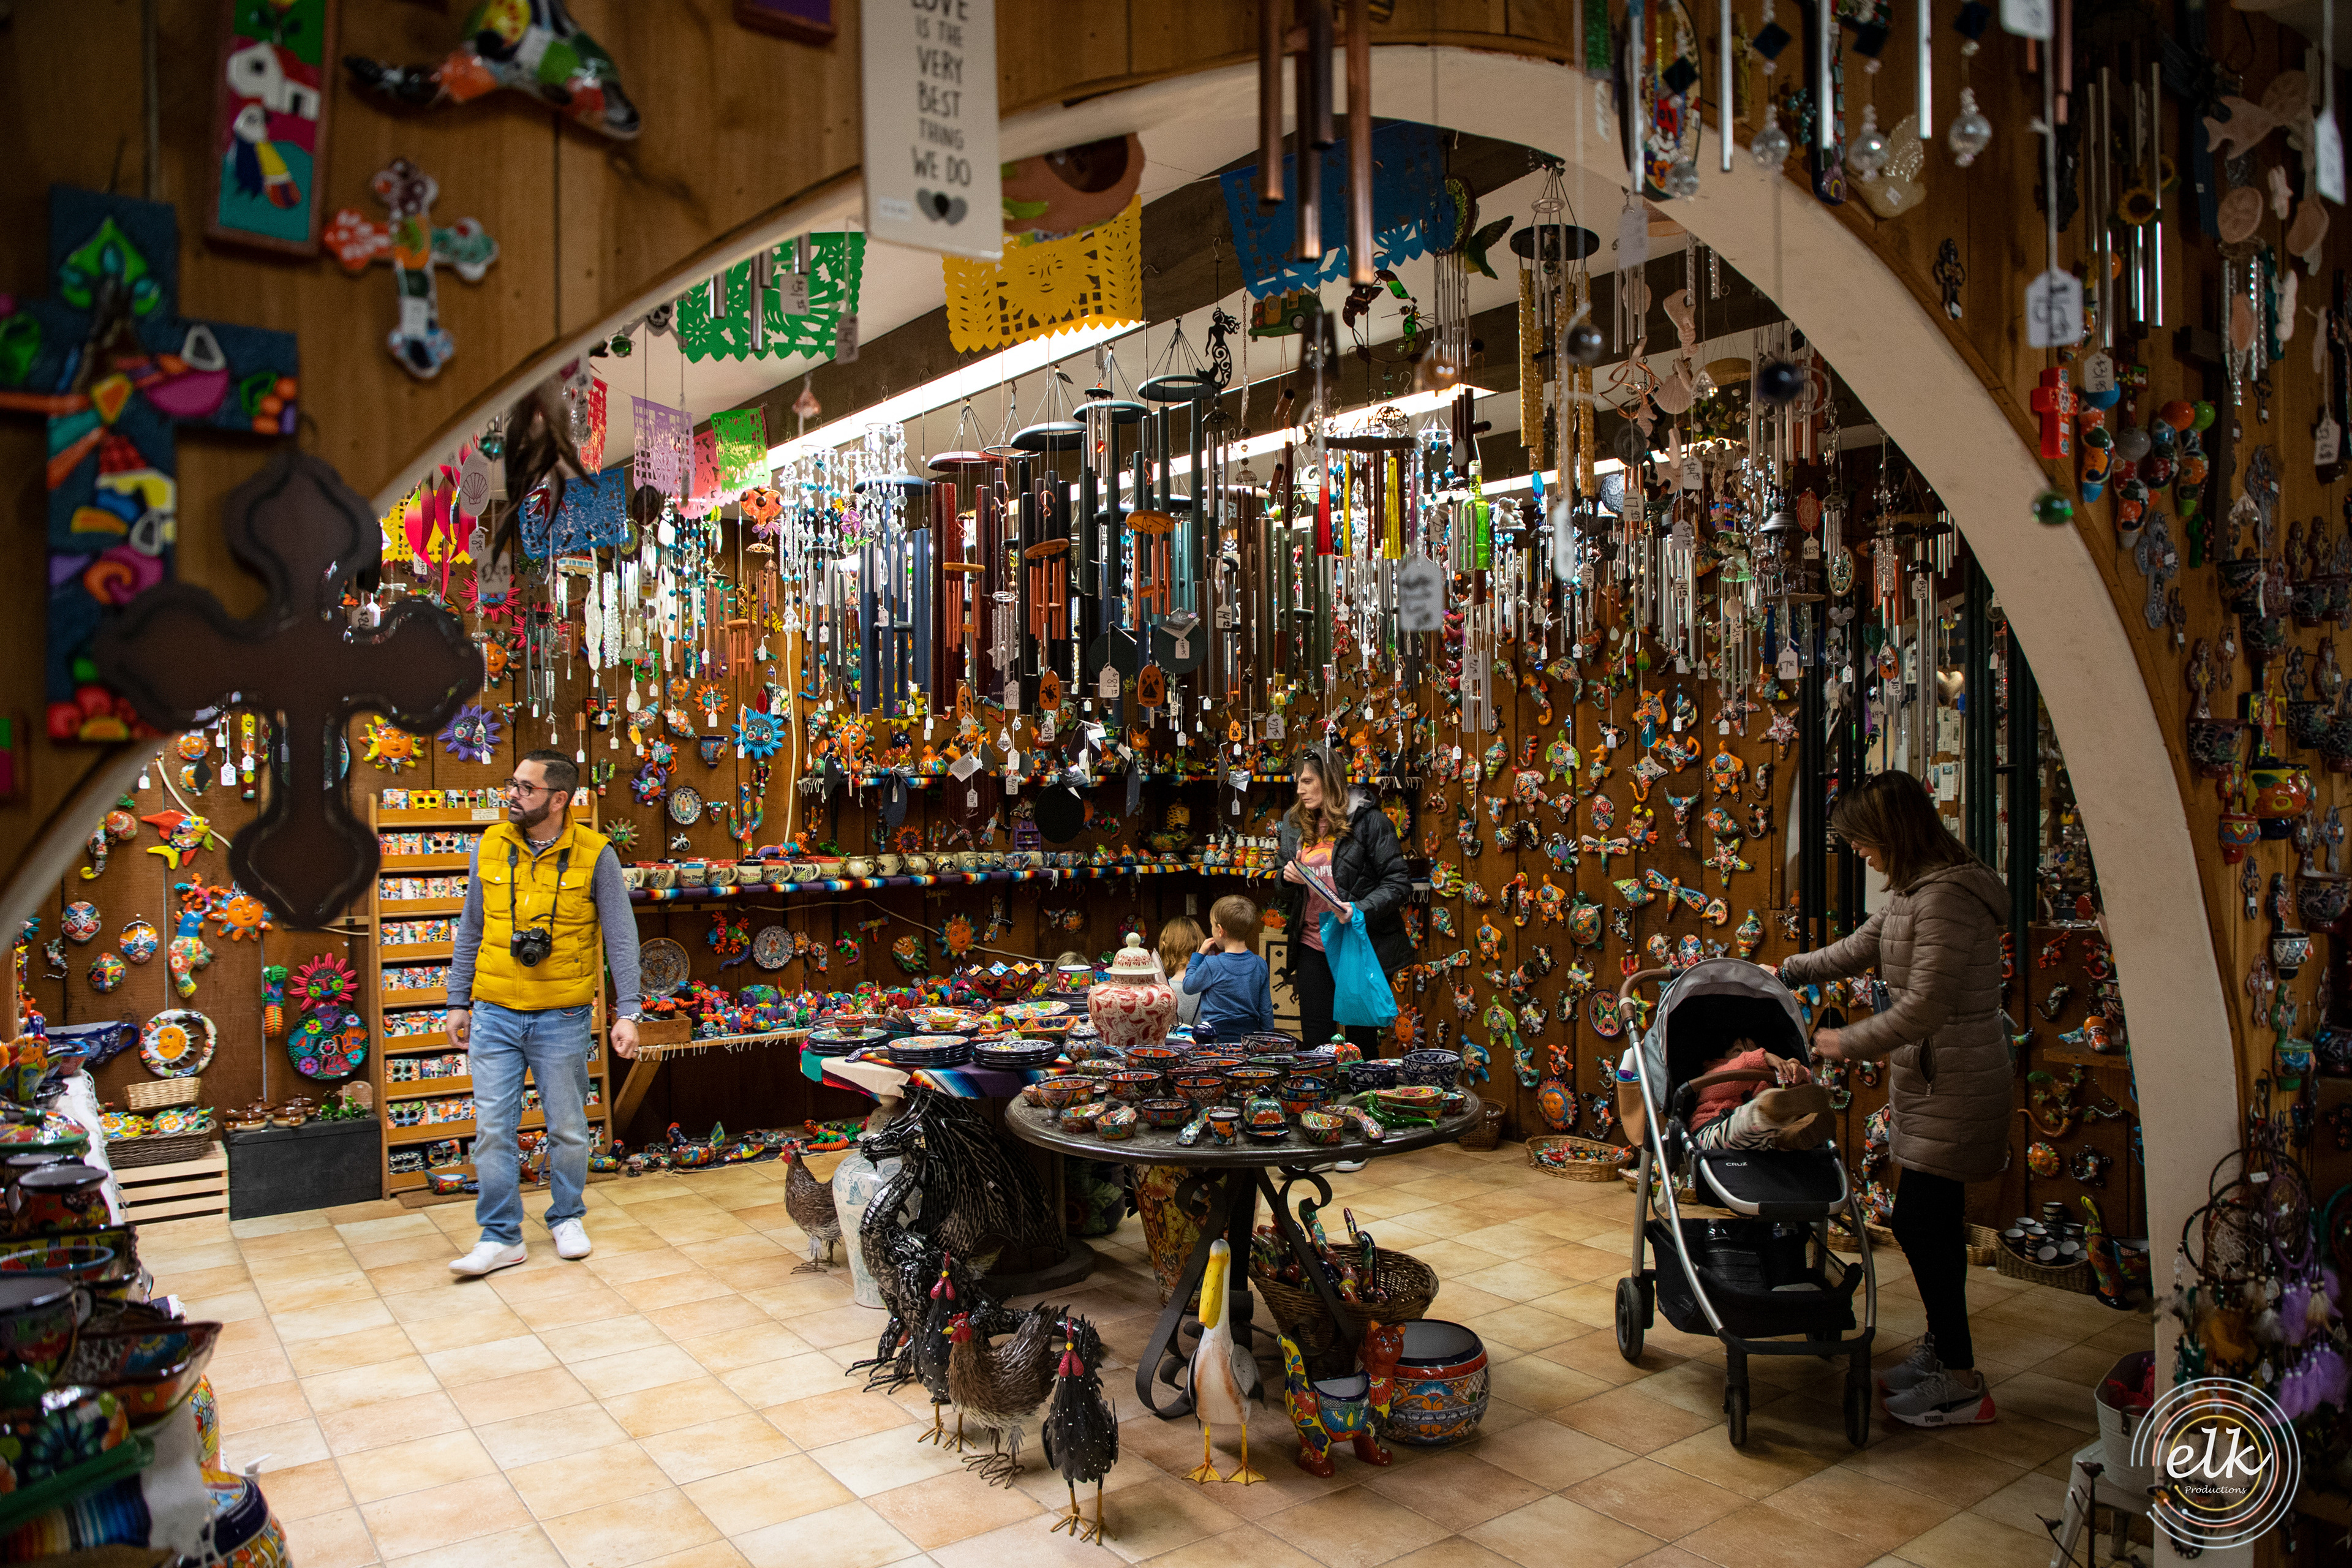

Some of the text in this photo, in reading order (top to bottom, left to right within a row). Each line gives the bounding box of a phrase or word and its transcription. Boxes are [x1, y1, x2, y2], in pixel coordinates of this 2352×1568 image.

[916, 16, 963, 48] IS THE
[917, 45, 963, 84] VERY
[918, 80, 961, 119] BEST
[919, 117, 964, 151] THING
[911, 145, 971, 186] WE DO
